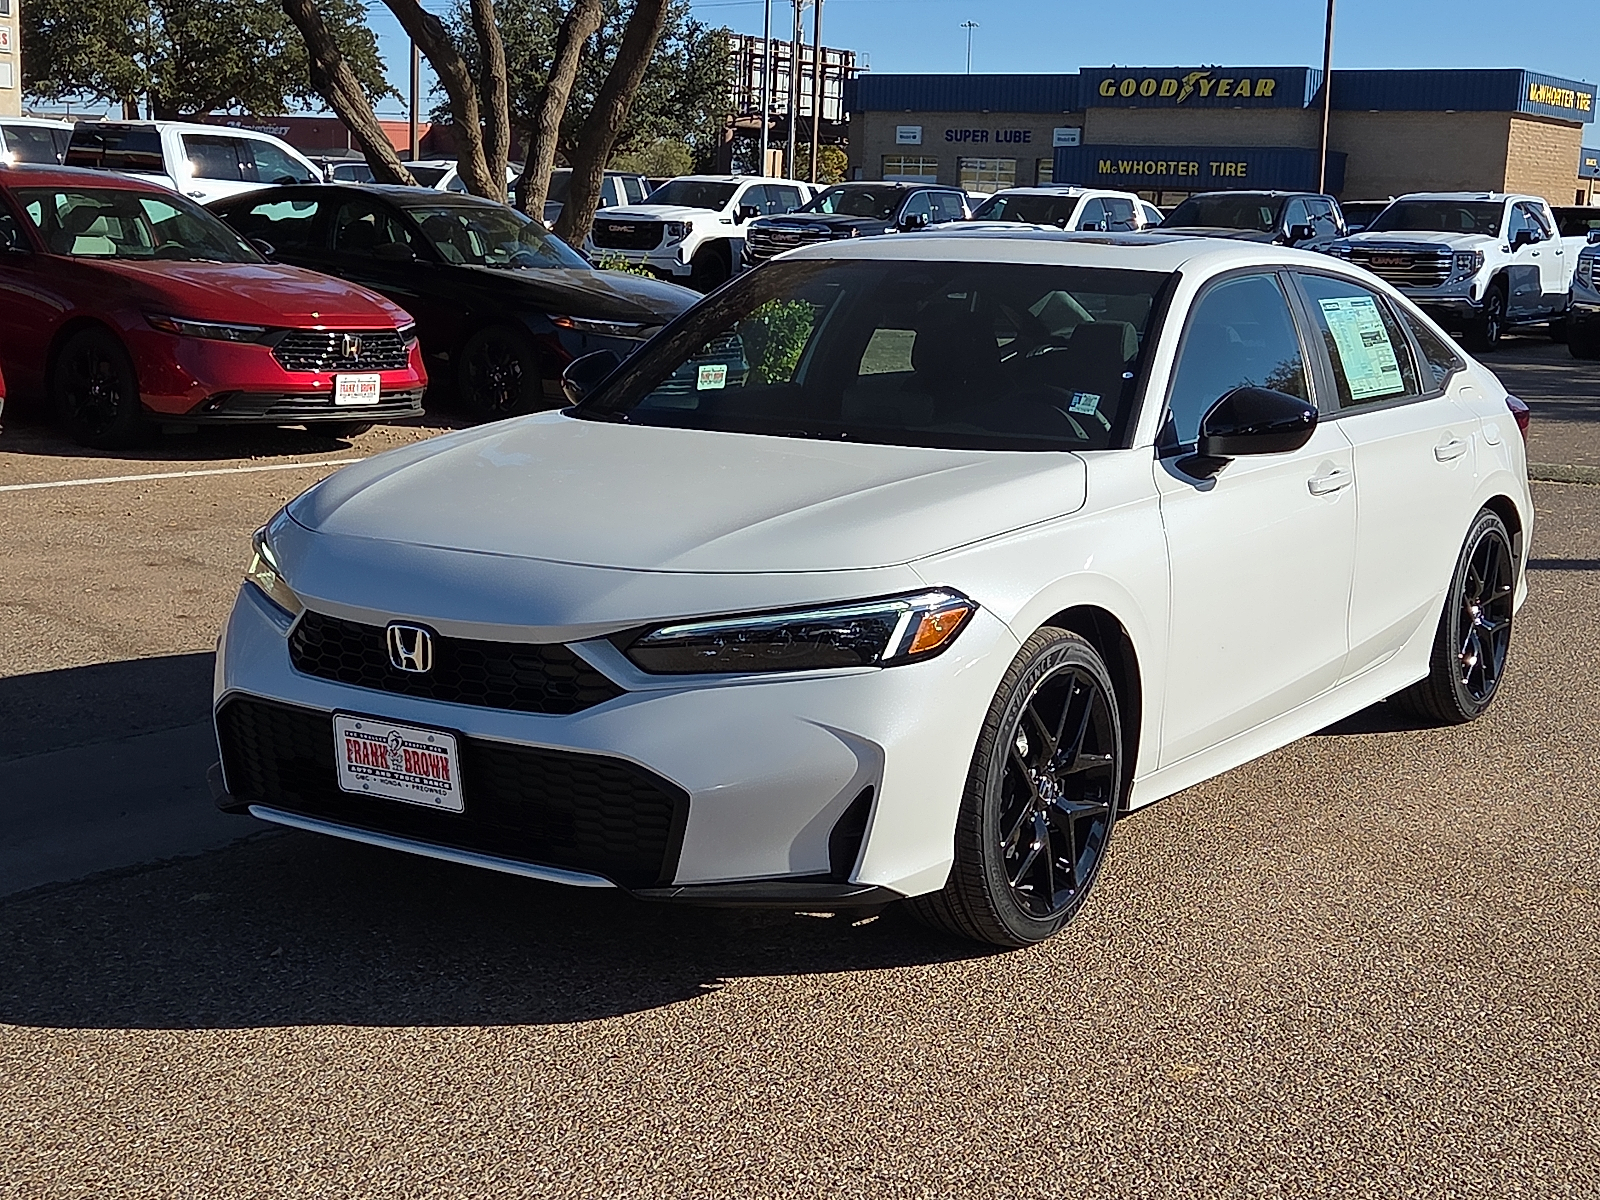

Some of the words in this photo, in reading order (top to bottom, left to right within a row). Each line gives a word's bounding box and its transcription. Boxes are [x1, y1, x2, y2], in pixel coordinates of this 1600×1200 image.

[1529, 83, 1575, 109] McWHORTER
[944, 129, 989, 143] SUPER
[995, 130, 1032, 144] LUBE
[1098, 160, 1199, 176] McWHORTER
[1209, 162, 1248, 177] TIRE
[1371, 256, 1412, 265] GMC
[345, 738, 390, 770] FRANK
[403, 748, 450, 782] BROWN
[350, 766, 373, 774] AUTO
[375, 769, 392, 778] AND
[393, 773, 421, 783] TRUCK
[423, 777, 450, 789] RANCH
[355, 773, 370, 782] GMC
[380, 778, 402, 788] HONDA
[411, 783, 447, 796] PREOWNED
